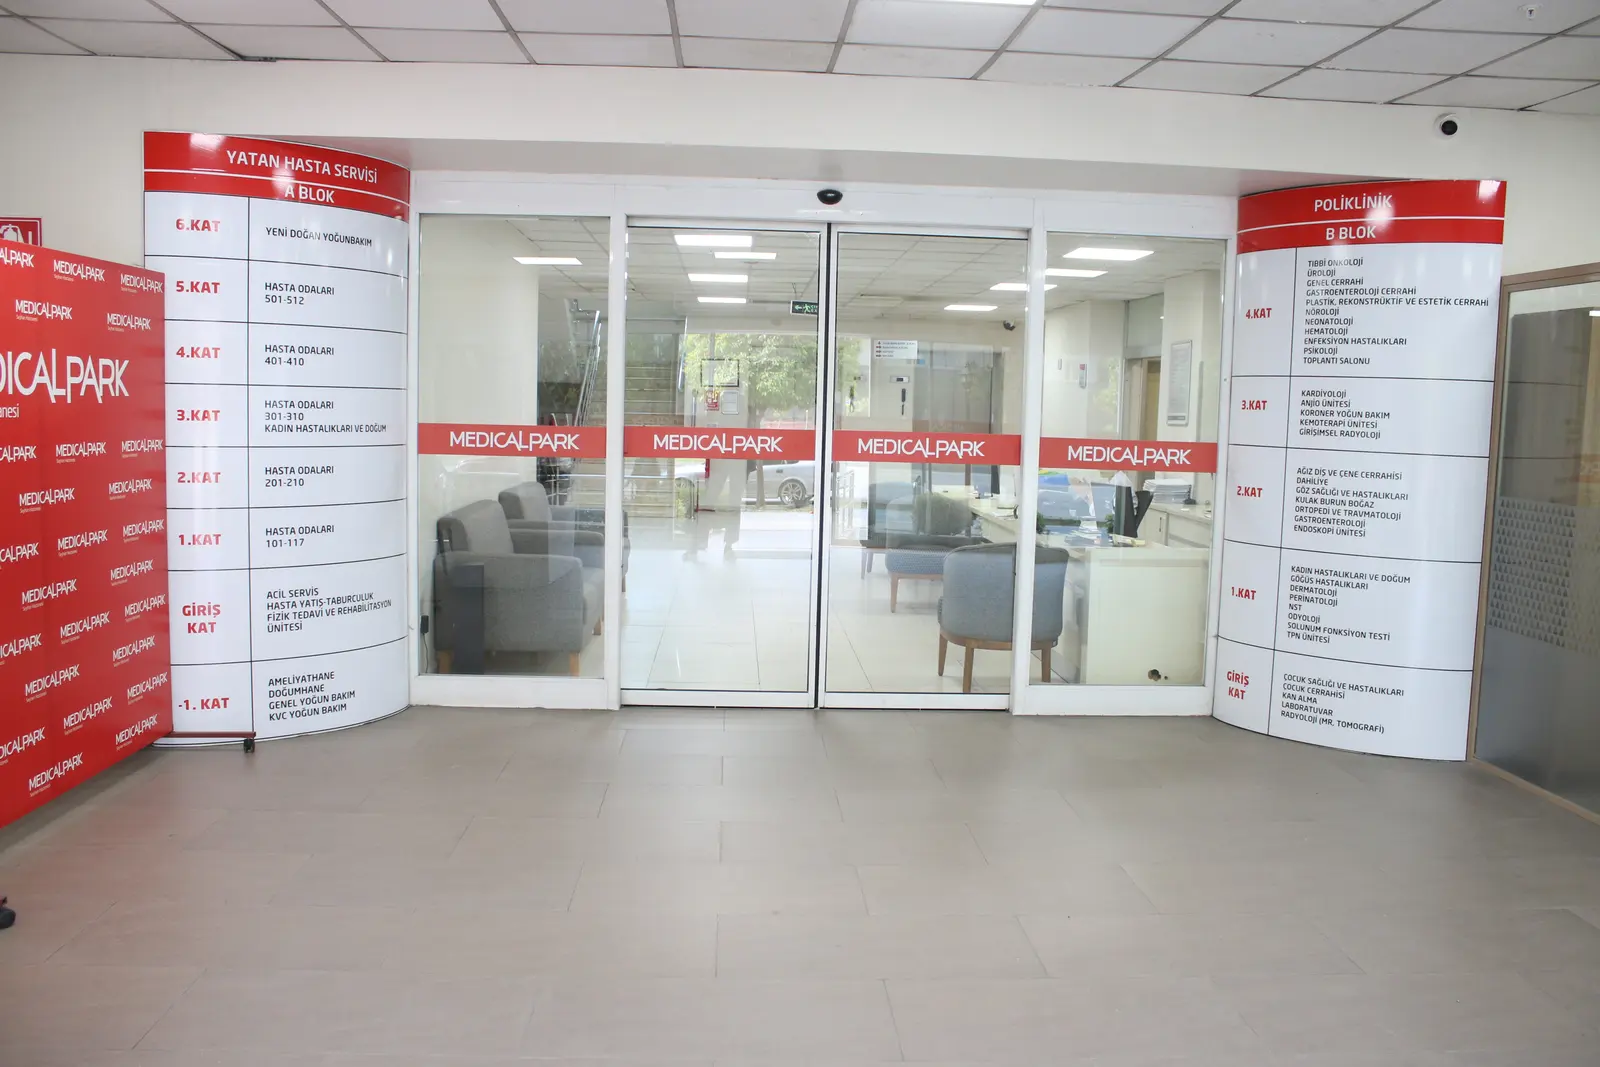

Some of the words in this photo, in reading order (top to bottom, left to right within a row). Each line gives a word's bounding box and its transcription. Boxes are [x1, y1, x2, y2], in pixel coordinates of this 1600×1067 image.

[227, 150, 280, 168] YATAN
[285, 156, 330, 175] HASTA
[334, 164, 377, 184] SERVİSİ
[285, 185, 294, 198] A
[299, 186, 334, 203] BLOK
[1314, 192, 1392, 212] POLİKLİNİK
[176, 218, 220, 232] 6.KAT
[266, 227, 287, 237] YENİ
[290, 229, 320, 240] DOĞAN
[323, 232, 372, 247] YOĞUNBAKIM
[1326, 228, 1334, 240] B
[1339, 226, 1376, 239] BLOK
[1308, 258, 1326, 267] TIBBİ
[1328, 257, 1363, 266] ONKOLOJİ
[1307, 269, 1336, 277] ÜROLOJİ
[176, 281, 220, 294] 5.KAT
[1331, 277, 1363, 286] CERRAHİ
[264, 282, 296, 293] HASTA
[298, 283, 334, 295] ODALARI
[1306, 287, 1379, 296] GASTROENTEROLOJİ
[1381, 286, 1416, 295] CERRAHİ
[264, 294, 304, 305] 501-512
[1339, 297, 1403, 305] REKONSTRÜKTİF
[1418, 297, 1451, 306] ESTETİK
[1454, 298, 1489, 306] CERRAHİ
[1245, 308, 1272, 319] 4.KAT
[1305, 307, 1339, 316] NÖROLOJİ
[1305, 317, 1353, 326] NEONATOLOJİ
[1305, 327, 1348, 336] HEMATOLOJİ
[1304, 337, 1349, 345] ENFEKSİYON
[176, 346, 220, 358] 4.KAT
[264, 344, 296, 354] HASTA
[298, 345, 334, 356] ODALARI
[1304, 346, 1338, 355] PSİKOLOJİ
[264, 356, 304, 366] 401-410
[1301, 389, 1346, 399] KARDİYOLOJİ
[264, 400, 295, 408] HASTA
[298, 401, 334, 409] ODALARI
[1241, 400, 1268, 410] 3.KAT
[1301, 398, 1320, 408] ANJİO
[1322, 399, 1350, 408] ÜNİTESİ
[176, 409, 220, 421] 3.KAT
[265, 412, 304, 420] 301-310
[1337, 409, 1363, 418] YOĞUN
[264, 424, 293, 432] KADIN
[296, 424, 353, 433] HASTALIKLARI
[365, 423, 386, 432] DOĞUM
[1300, 419, 1345, 427] KEMOTERAPİ
[1347, 420, 1378, 428] ÜNİTESİ
[1300, 427, 1338, 437] GİRİŞİMSEL
[1340, 430, 1380, 440] RADYOLOJİ
[450, 431, 579, 452] MEDICALPARK
[653, 433, 783, 454] MEDICALPARK
[858, 438, 985, 458] MEDICALPARK
[1068, 446, 1191, 466] MEDICALPARK
[265, 466, 296, 475] HASTA
[298, 465, 334, 475] ODALARI
[1297, 466, 1313, 475] AĞIZ
[1315, 468, 1326, 477] DİŞ
[1340, 470, 1359, 478] ÇENE
[1361, 471, 1402, 480] CERRAHİSİ
[177, 471, 221, 484] 2.KAT
[265, 477, 304, 488] 201-210
[1296, 477, 1328, 485] DAHİLİYE
[1236, 486, 1262, 498] 2.KAT
[1312, 487, 1339, 497] SAĞLIĞI
[1352, 491, 1408, 500] HASTALIKLARI
[1296, 496, 1318, 504] KULAK
[1349, 499, 1375, 508] BOĞAZ
[1295, 506, 1330, 514] ORTOPEDİ
[1344, 509, 1401, 521] TRAVMATOLOJİ
[1294, 516, 1366, 528] GASTROENTEROLOJİ
[265, 527, 297, 536] HASTA
[298, 525, 334, 535] ODALARI
[1294, 525, 1334, 534] ENDOSKOPİ
[1336, 528, 1366, 537] ÜNİTESİ
[178, 534, 222, 546] 1.KAT
[266, 538, 304, 548] 101-117
[1291, 566, 1312, 574] KADIN
[1314, 568, 1367, 580] HASTALIKLARI
[1381, 574, 1411, 583] DOĞUM
[1290, 575, 1314, 584] GÖĞÜS
[1316, 578, 1368, 590] HASTALIKLARI
[267, 589, 286, 599] ACİL
[289, 586, 319, 598] SERVİS
[1231, 586, 1256, 600] 1.KAT
[1290, 584, 1338, 597] DERMATOLOJİ
[267, 601, 297, 610] HASTA
[300, 592, 374, 608] YATIŞ-TABURCULUK
[1290, 594, 1338, 607] PERİNATOLOJİ
[182, 602, 221, 617] GİRİŞ
[267, 612, 290, 621] FİZİK
[293, 608, 323, 620] TEDAVİ
[326, 608, 335, 616] VE
[337, 599, 392, 615] REHABİLİTASYON
[1288, 613, 1320, 624] ODYOLOJİ
[187, 622, 216, 634] KAT
[267, 621, 302, 633] ÜNİTESİ
[1287, 622, 1321, 633] SOLUNUM
[1323, 627, 1366, 638] FONKSİYON
[1369, 632, 1390, 640] TESTİ
[1287, 631, 1300, 639] TPN
[1302, 632, 1330, 643] ÜNİTESİ
[268, 671, 335, 686] AMELİYATHANE
[1226, 670, 1250, 686] GİRİŞ
[269, 684, 324, 698] DOĞUMHANE
[1283, 683, 1305, 692] ÇOCUK
[1307, 687, 1345, 699] CERRAHİSİ
[1284, 674, 1306, 683] ÇOCUK
[1308, 677, 1335, 688] SAĞLIĞI
[1349, 684, 1404, 696] HASTALIKLARI
[1228, 686, 1246, 700] KAT
[1282, 692, 1296, 700] KAN
[1298, 695, 1317, 704] ALMA
[178, 699, 196, 710] -1.
[200, 698, 230, 710] KAT
[269, 699, 297, 710] GENEL
[300, 695, 329, 706] YOĞUN
[332, 690, 356, 701] BAKIM
[269, 712, 287, 721] KVC
[289, 707, 320, 718] YOĞUN
[322, 704, 347, 714] BAKIM
[1282, 702, 1333, 716] LABORATUVAR
[1281, 710, 1317, 723] RADYOLOJİ
[1337, 720, 1385, 734] TOMOGRAFİ)
